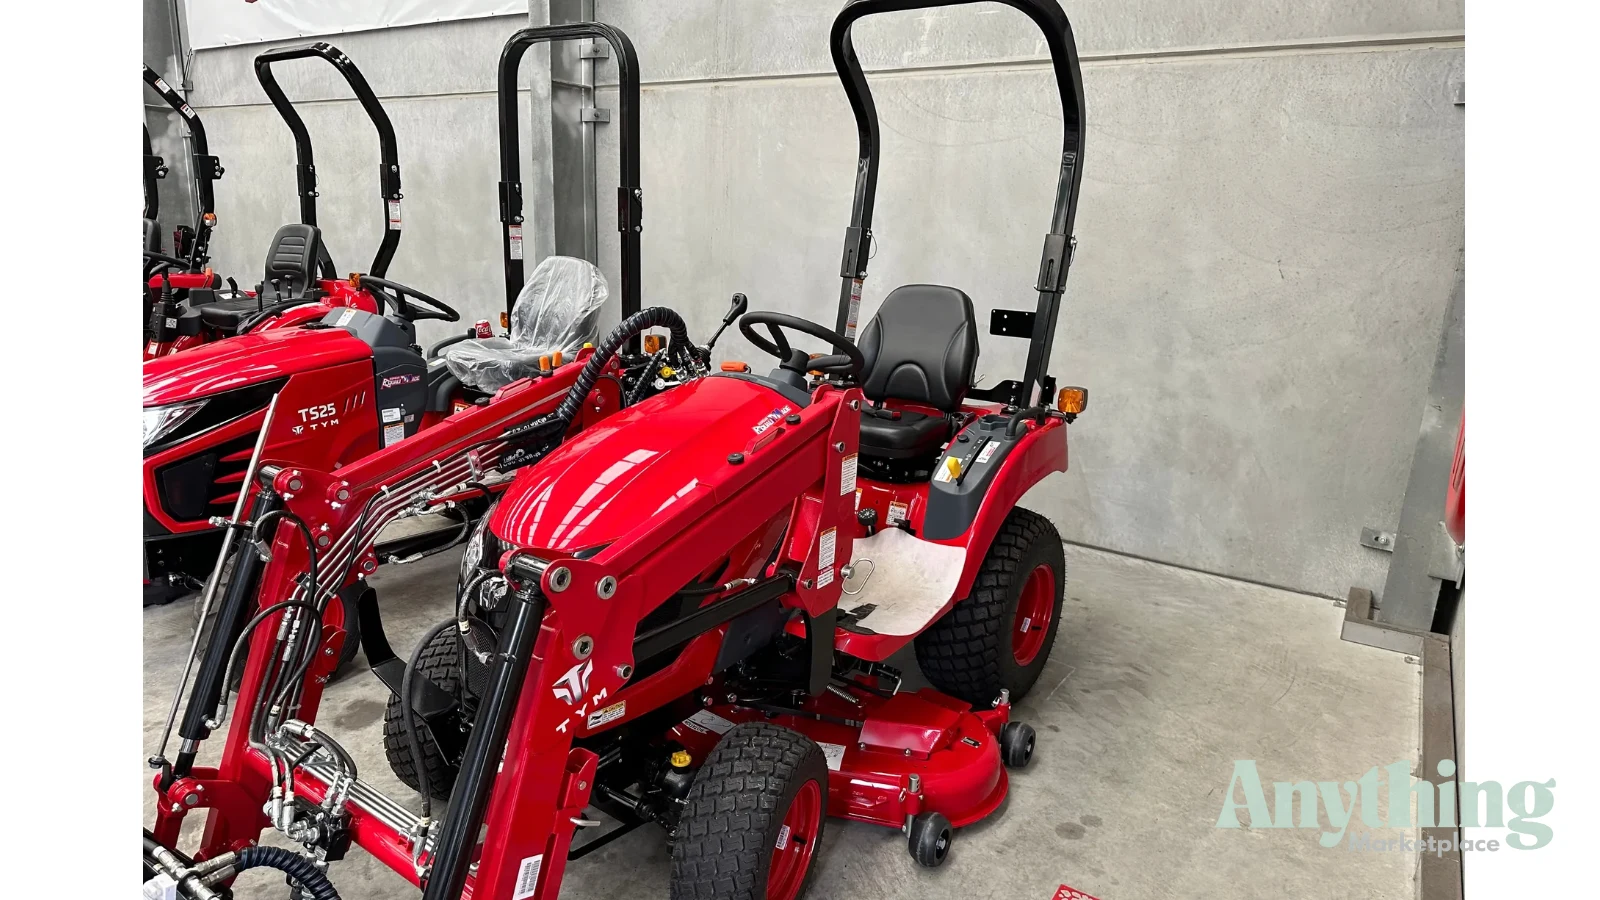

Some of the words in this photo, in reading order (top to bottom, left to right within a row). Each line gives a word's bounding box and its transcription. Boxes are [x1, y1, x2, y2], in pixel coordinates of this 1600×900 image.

[297, 402, 336, 423] TS25
[310, 418, 339, 431] TYM
[555, 687, 608, 734] TYM
